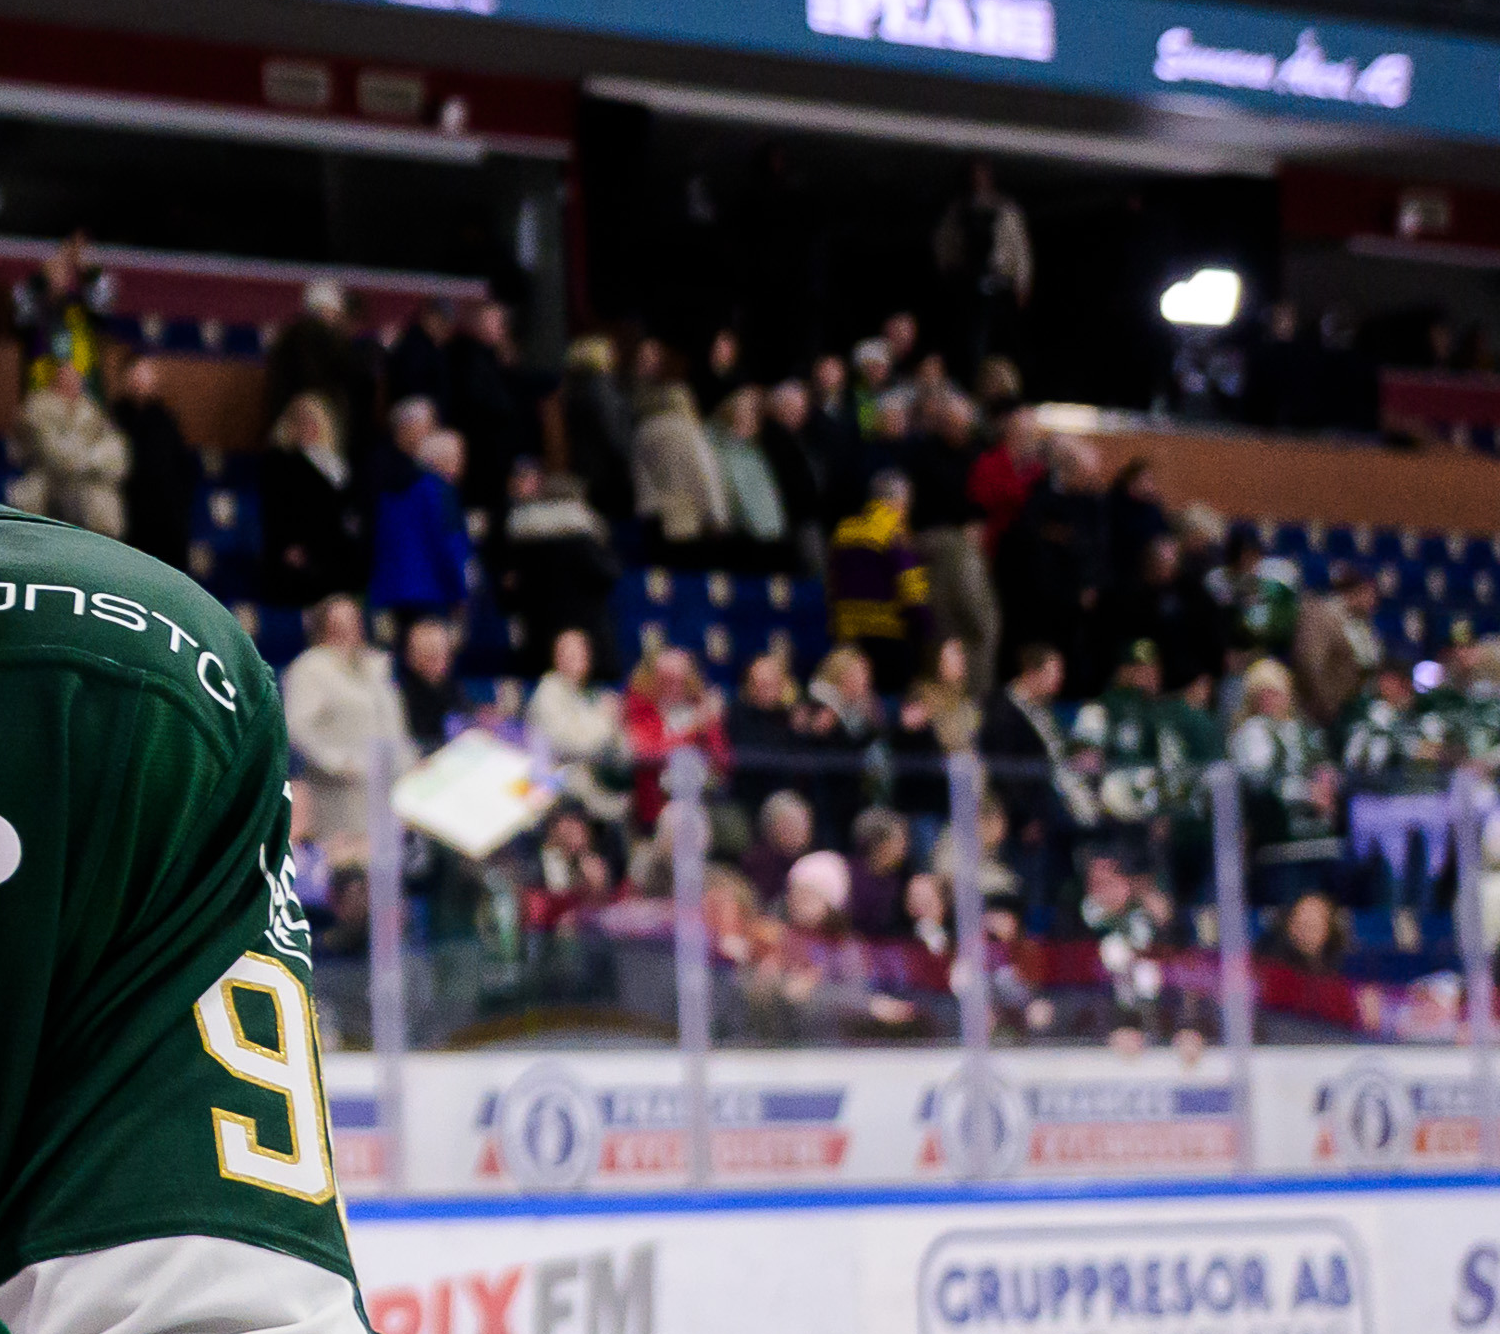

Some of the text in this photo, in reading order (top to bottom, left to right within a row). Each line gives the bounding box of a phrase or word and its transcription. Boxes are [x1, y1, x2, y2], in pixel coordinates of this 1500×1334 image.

[936, 1251, 1354, 1327] GRUPPRESOR AB
[1452, 1243, 1500, 1330] S
